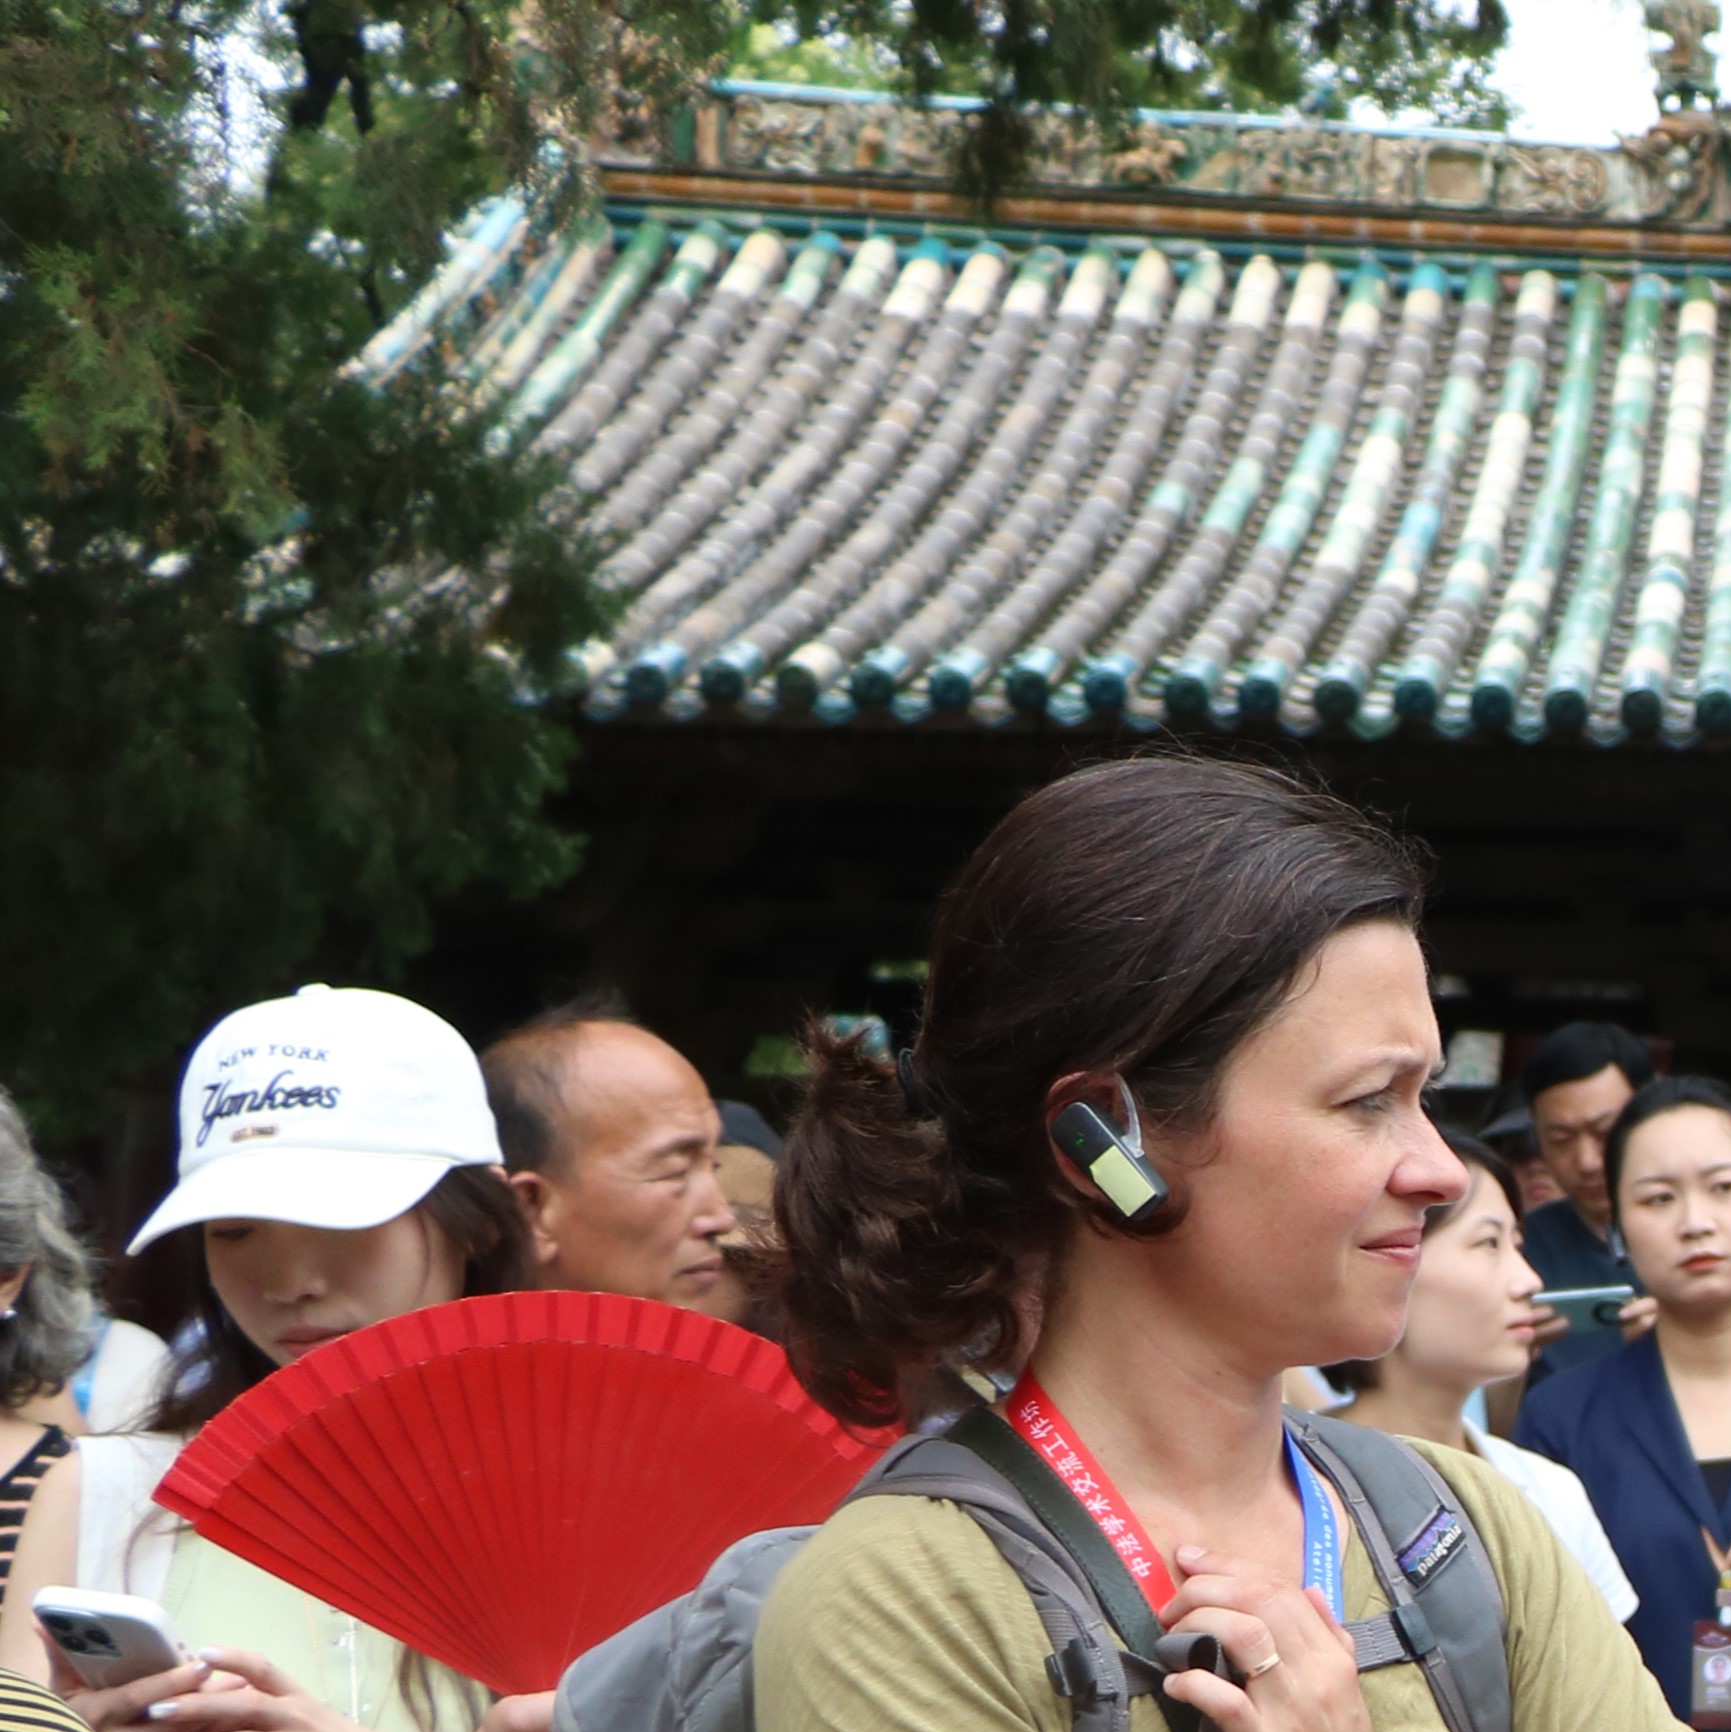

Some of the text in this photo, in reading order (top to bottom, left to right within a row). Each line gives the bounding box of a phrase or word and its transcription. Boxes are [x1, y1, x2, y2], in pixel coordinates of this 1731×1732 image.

[220, 1045, 329, 1070] NEW YORK
[197, 1070, 340, 1147] Yankees
[1017, 1400, 1151, 1579] 中法学术交流工作坊
[1323, 1523, 1334, 1548] des
[1417, 1525, 1462, 1576] patagonia
[1312, 1540, 1323, 1588] Atelie
[1323, 1552, 1335, 1615] monumen
